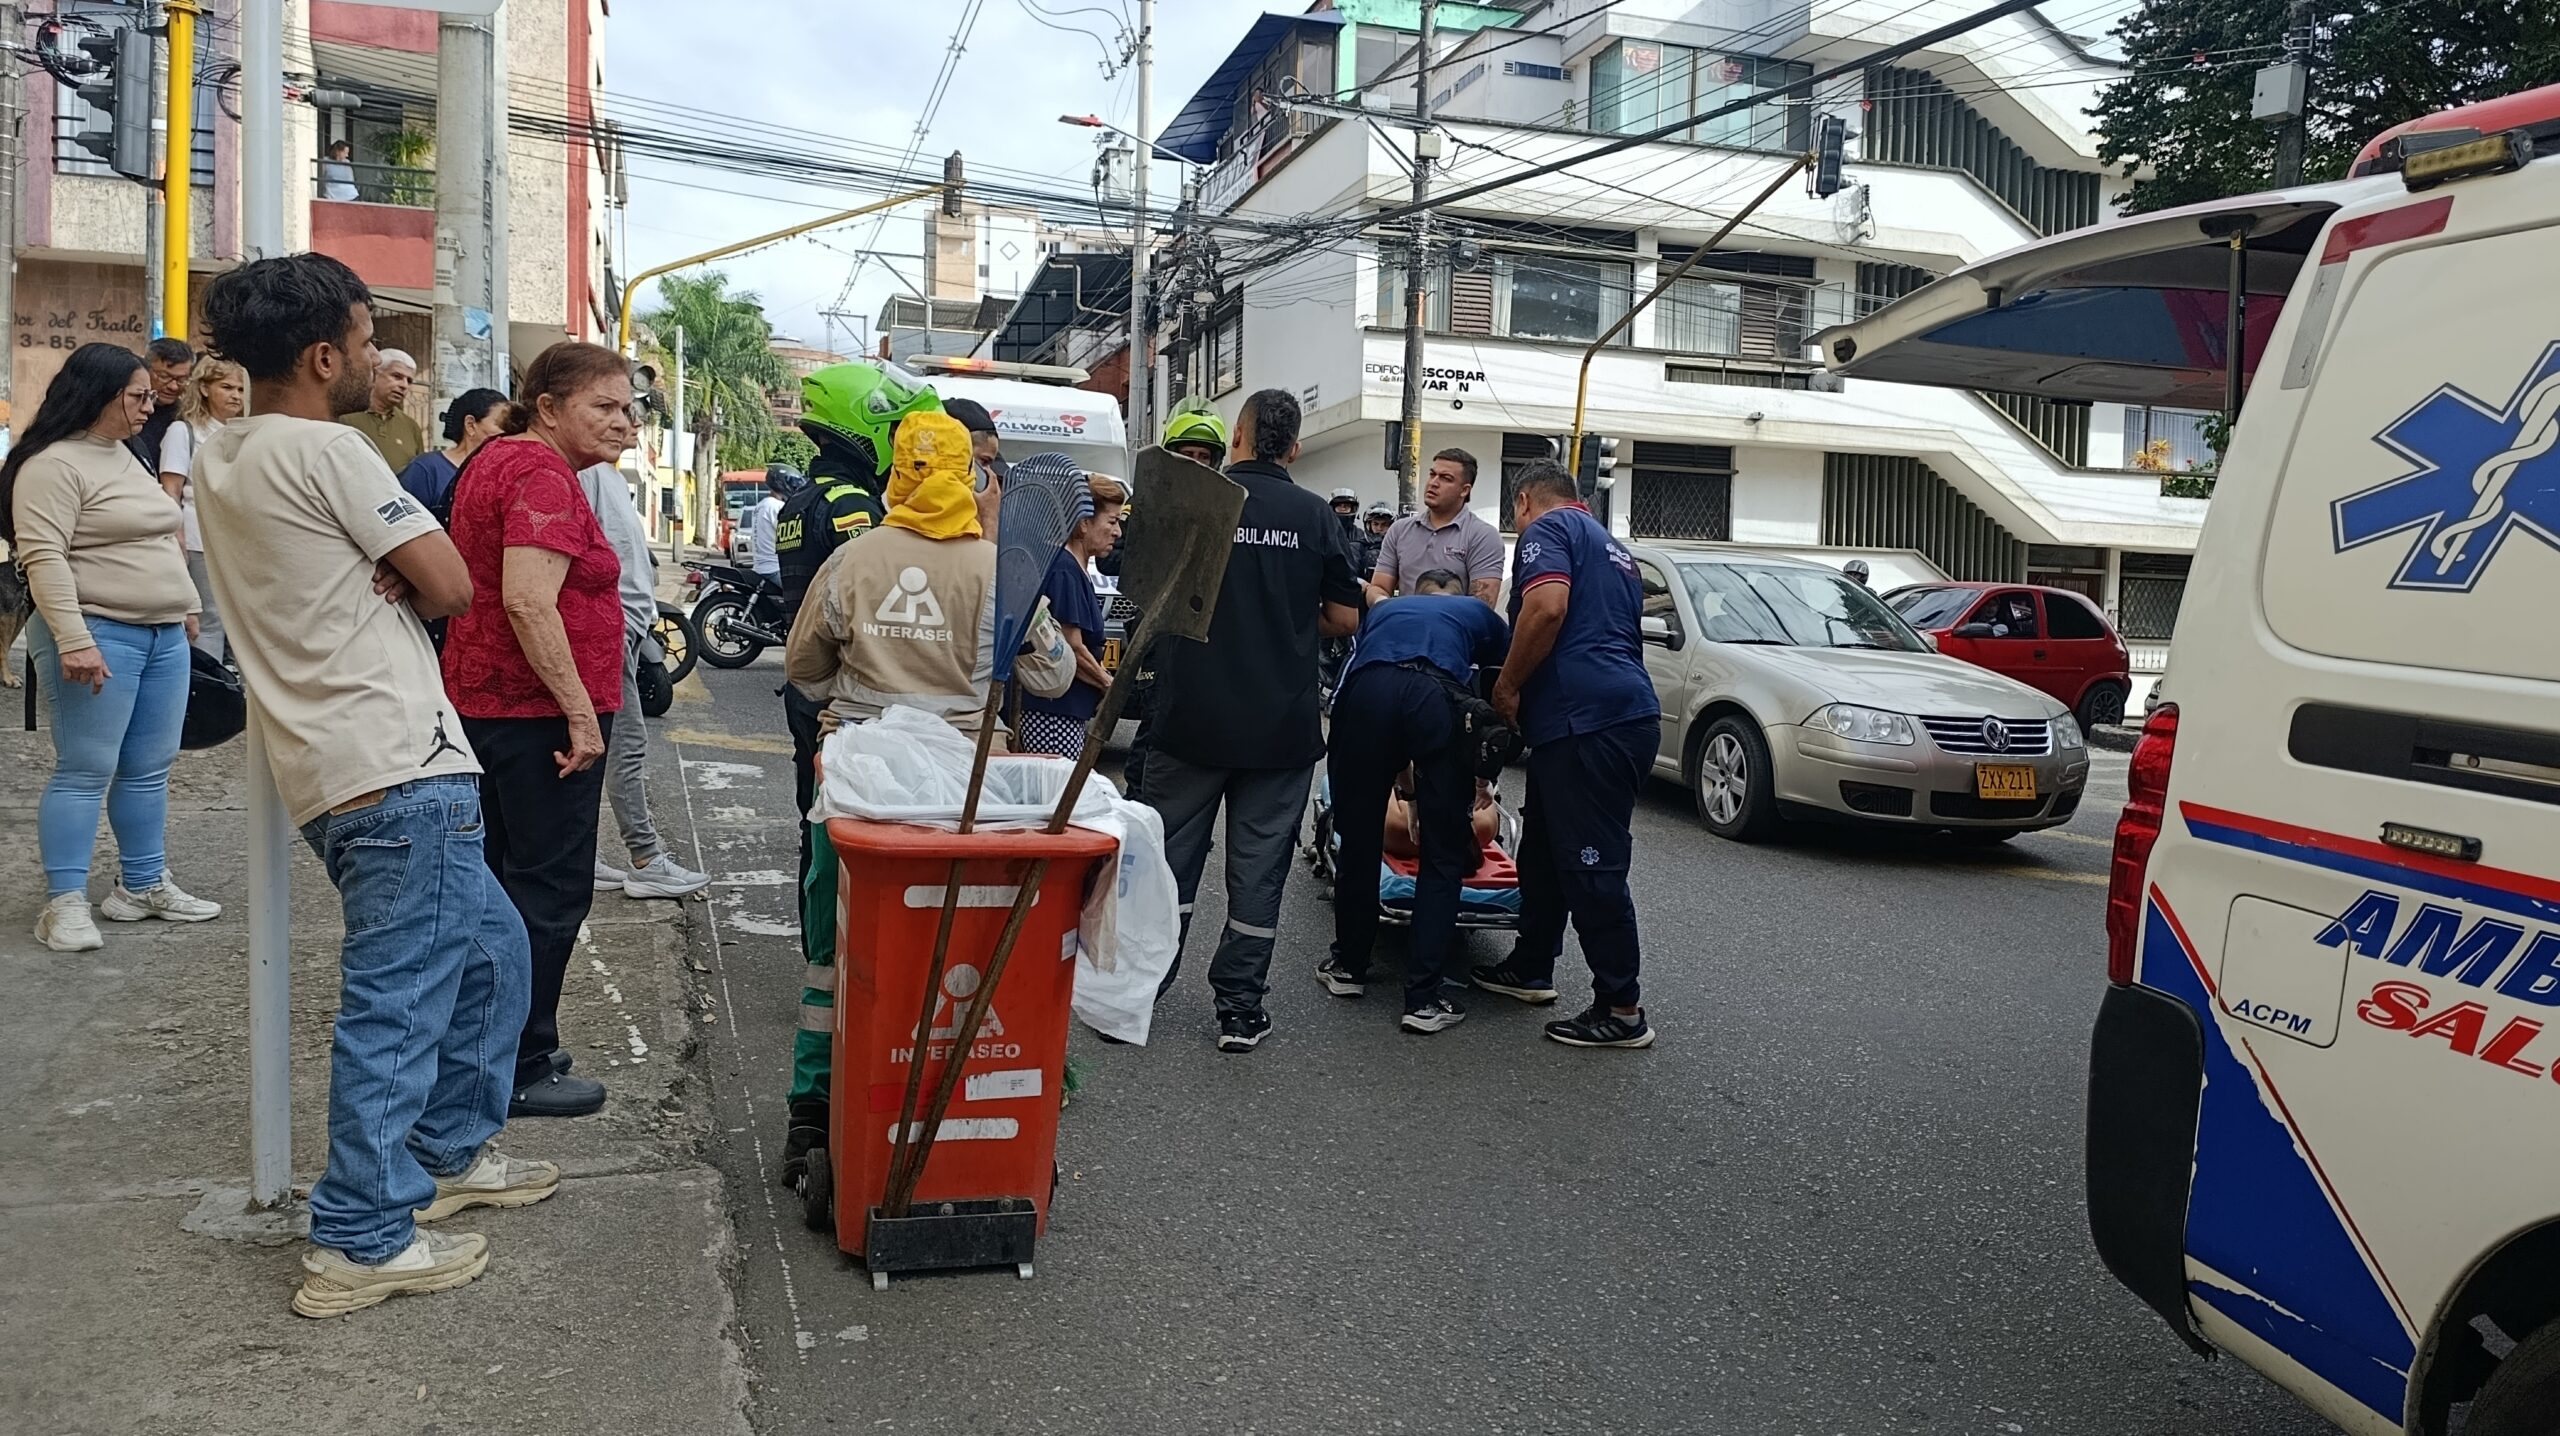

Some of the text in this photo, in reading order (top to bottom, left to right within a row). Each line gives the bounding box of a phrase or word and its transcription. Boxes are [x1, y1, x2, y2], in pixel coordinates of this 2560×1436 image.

[48, 311, 76, 328] del
[86, 309, 143, 333] Fraile
[20, 333, 77, 350] 3-85
[1365, 363, 1405, 375] EDIFICI
[2232, 998, 2312, 1034] ACPM
